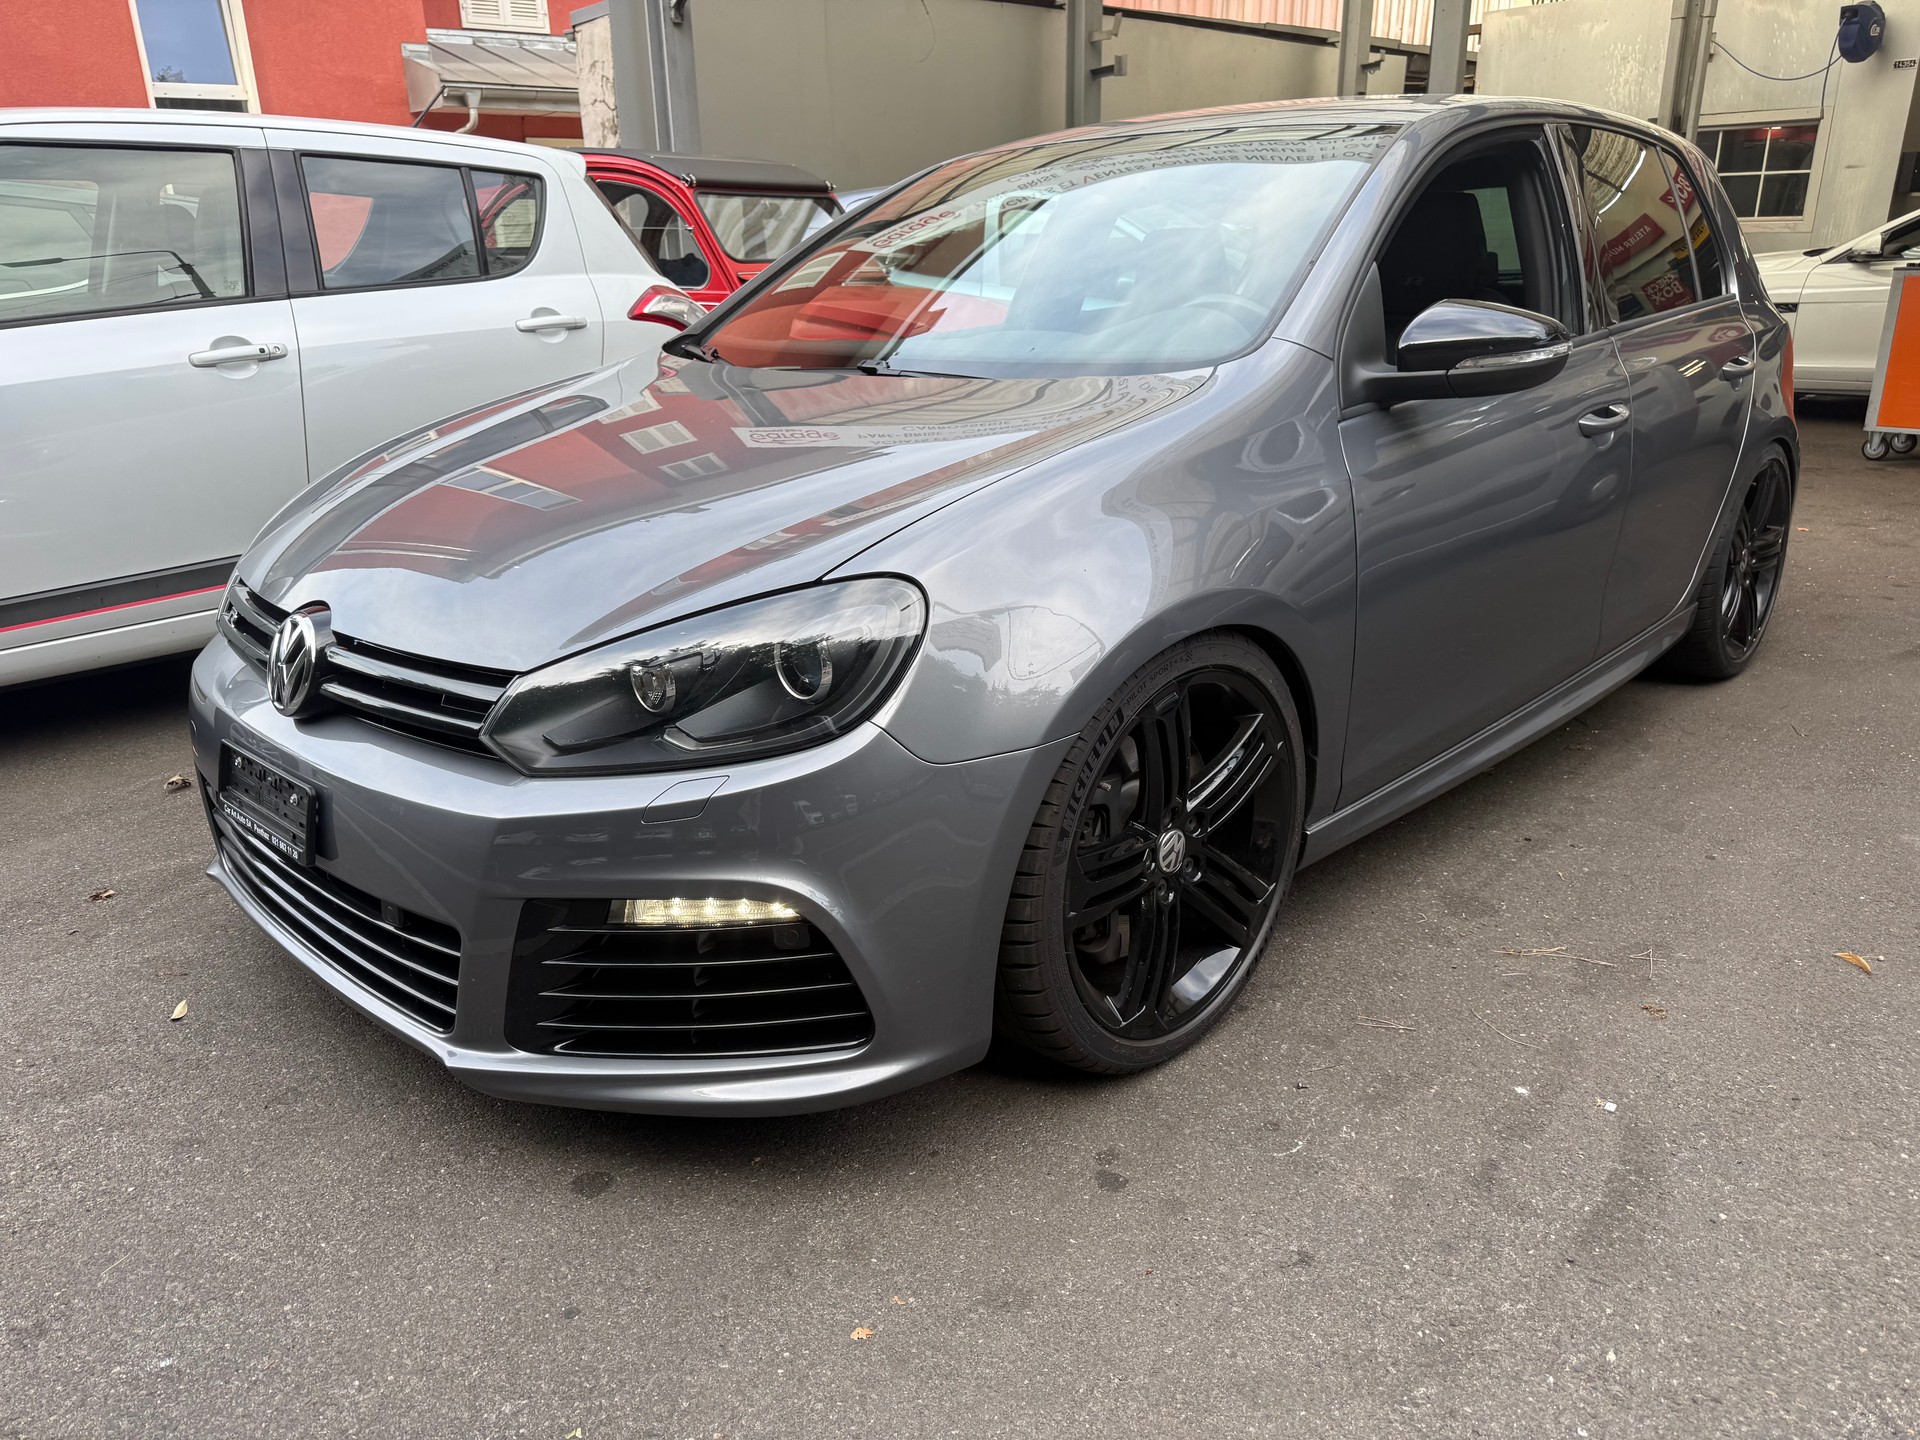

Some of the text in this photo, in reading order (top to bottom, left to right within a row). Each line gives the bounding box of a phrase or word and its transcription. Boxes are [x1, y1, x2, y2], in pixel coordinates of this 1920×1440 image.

[1126, 683, 1148, 704] PILOT
[1150, 662, 1175, 682] SPORT
[1062, 708, 1125, 832] MICHELIN
